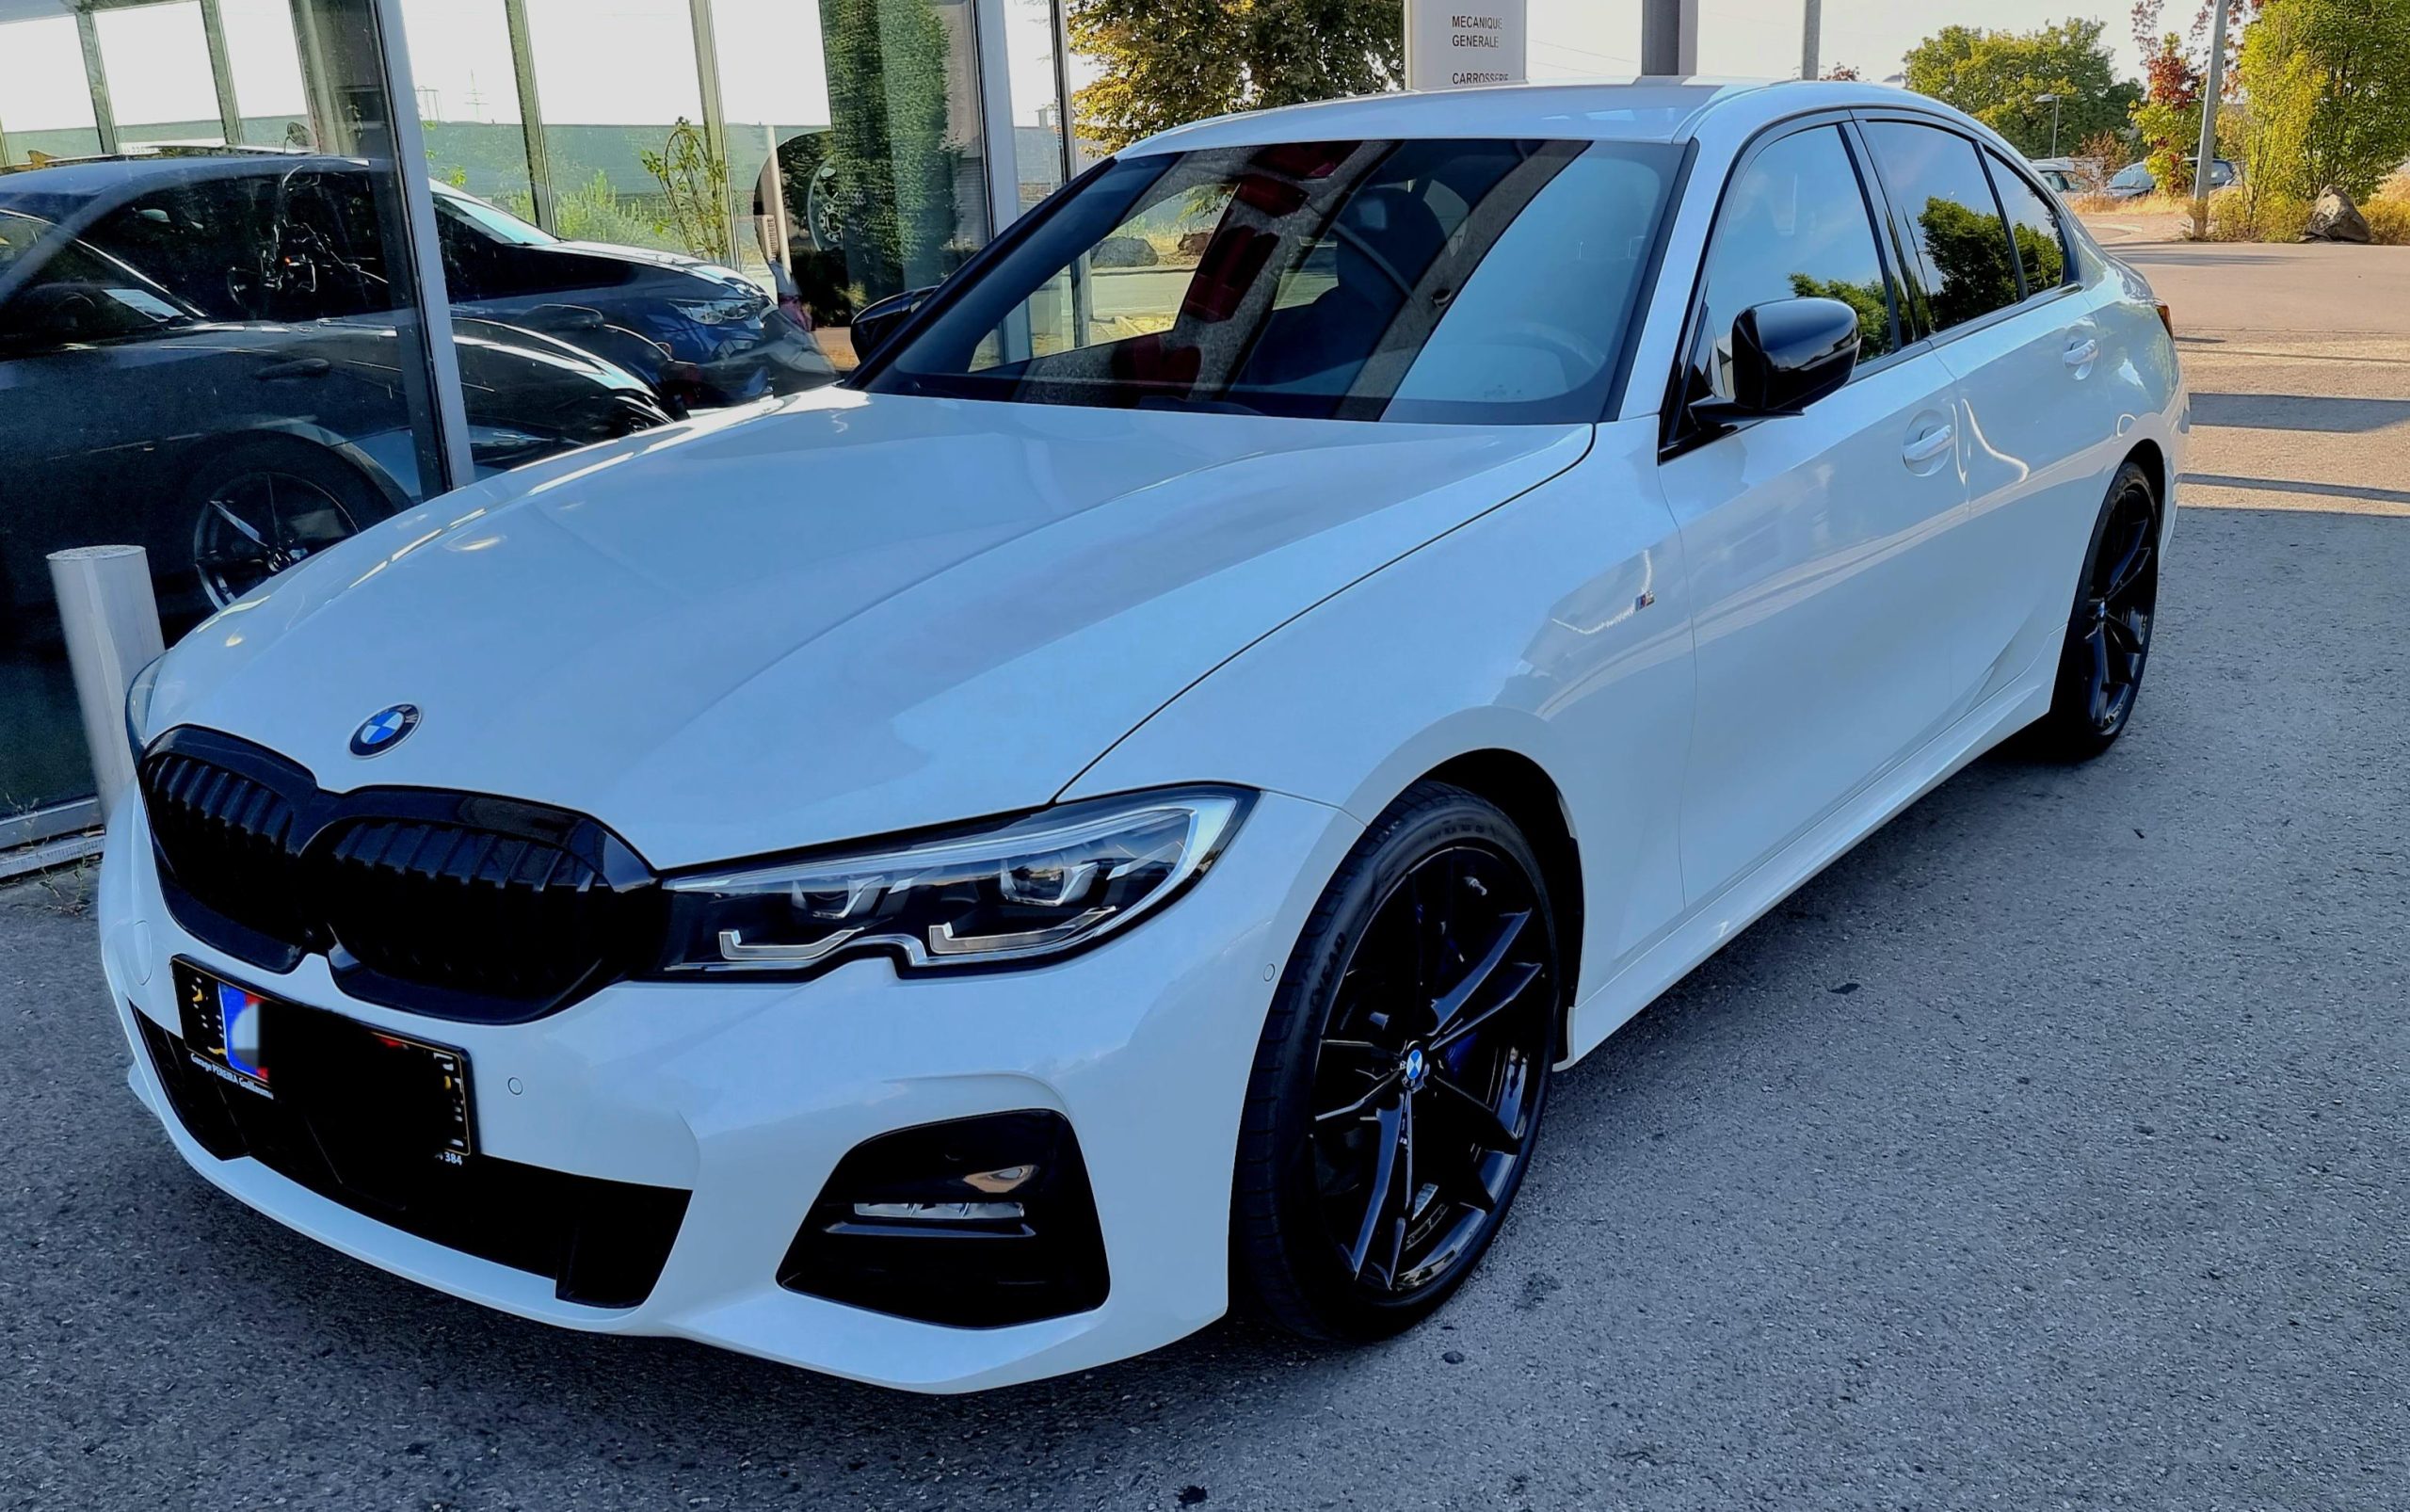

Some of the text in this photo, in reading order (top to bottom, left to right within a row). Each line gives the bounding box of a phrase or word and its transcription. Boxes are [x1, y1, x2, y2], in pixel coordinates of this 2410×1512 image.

[1452, 15, 1502, 30] MECANIQUE
[1452, 35, 1499, 48] GENERALE
[444, 1150, 463, 1166] 384
